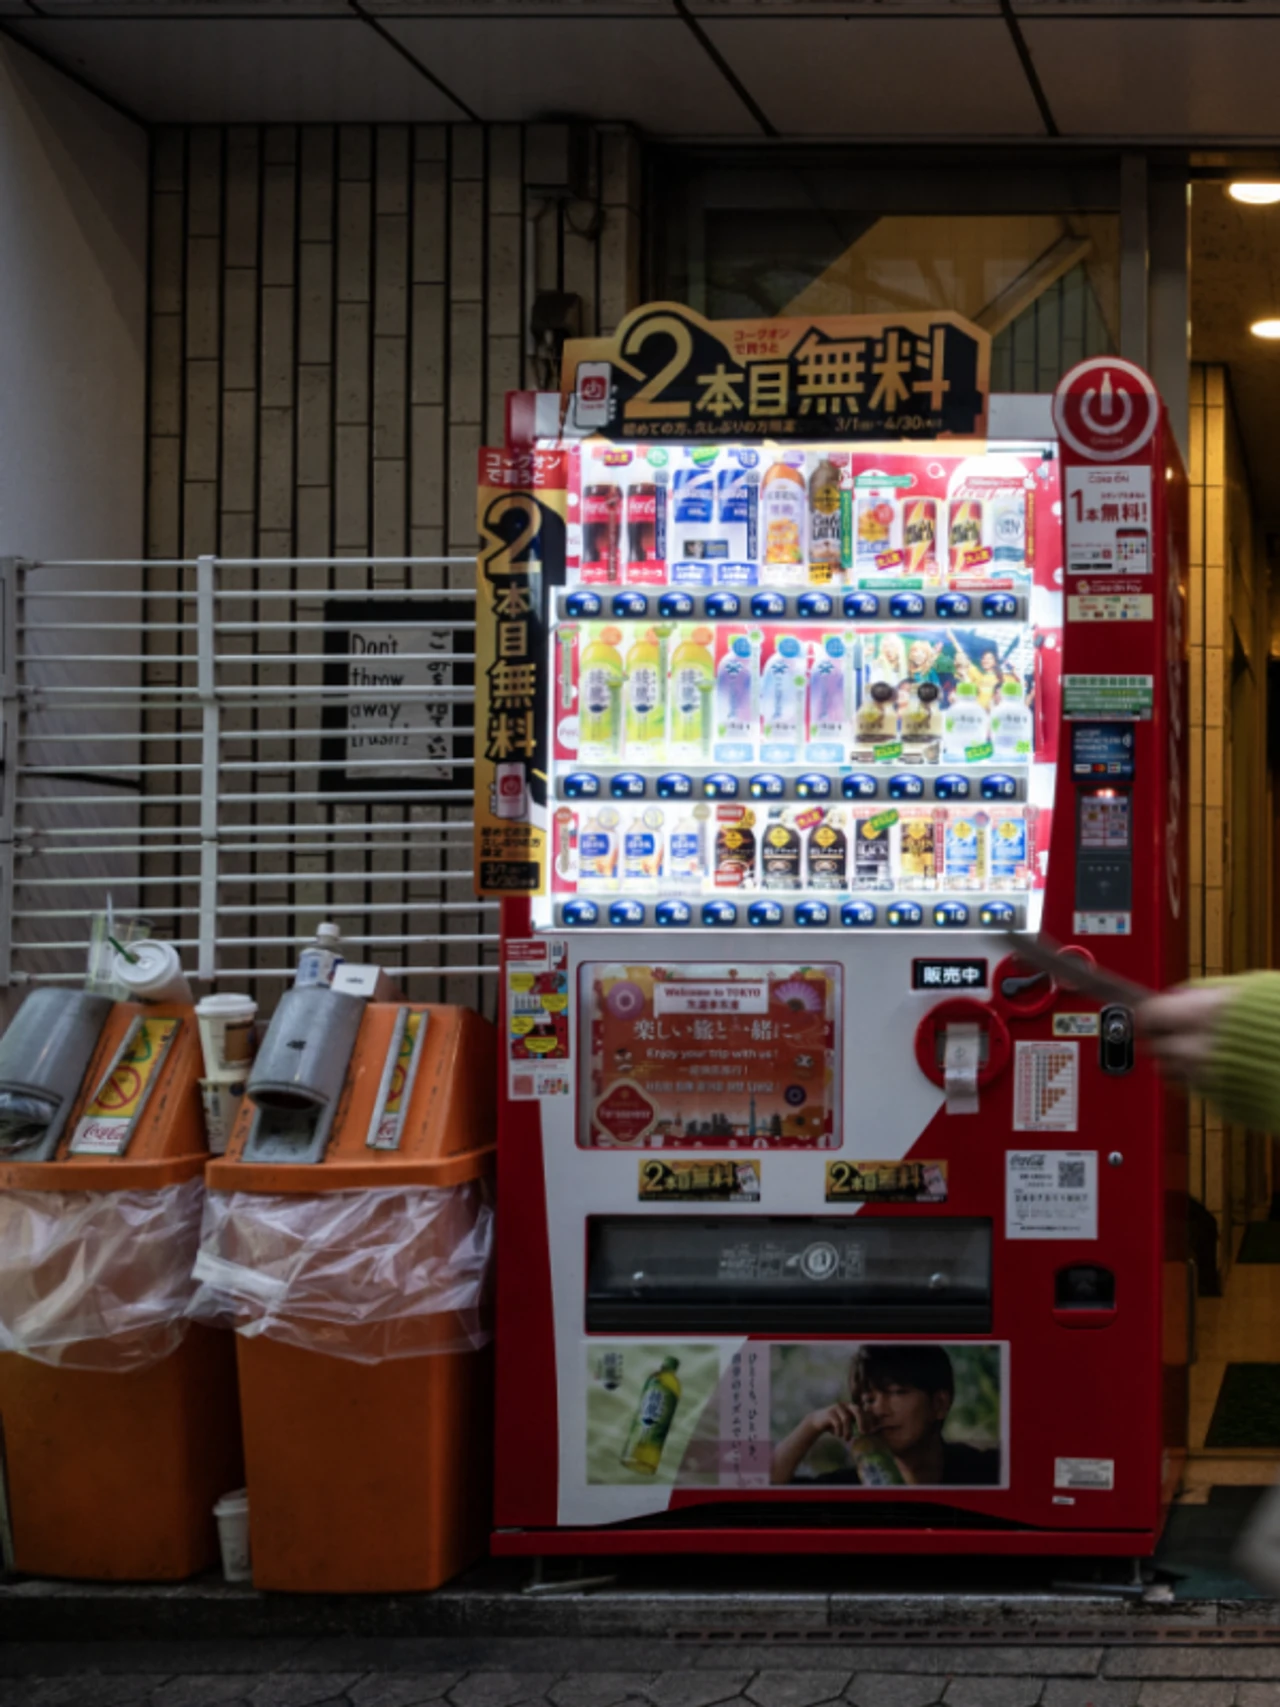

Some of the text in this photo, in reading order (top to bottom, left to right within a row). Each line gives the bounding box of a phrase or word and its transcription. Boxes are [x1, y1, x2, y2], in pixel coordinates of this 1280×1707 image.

[622, 320, 951, 420] 2本目無料
[487, 496, 542, 758] 2本目無料
[350, 703, 402, 725] away
[924, 966, 980, 983] 販売中
[665, 987, 761, 997] Welcome to TOKYO
[646, 1048, 677, 1059] Enjoy
[709, 1049, 729, 1059] trip
[731, 1048, 757, 1058] with
